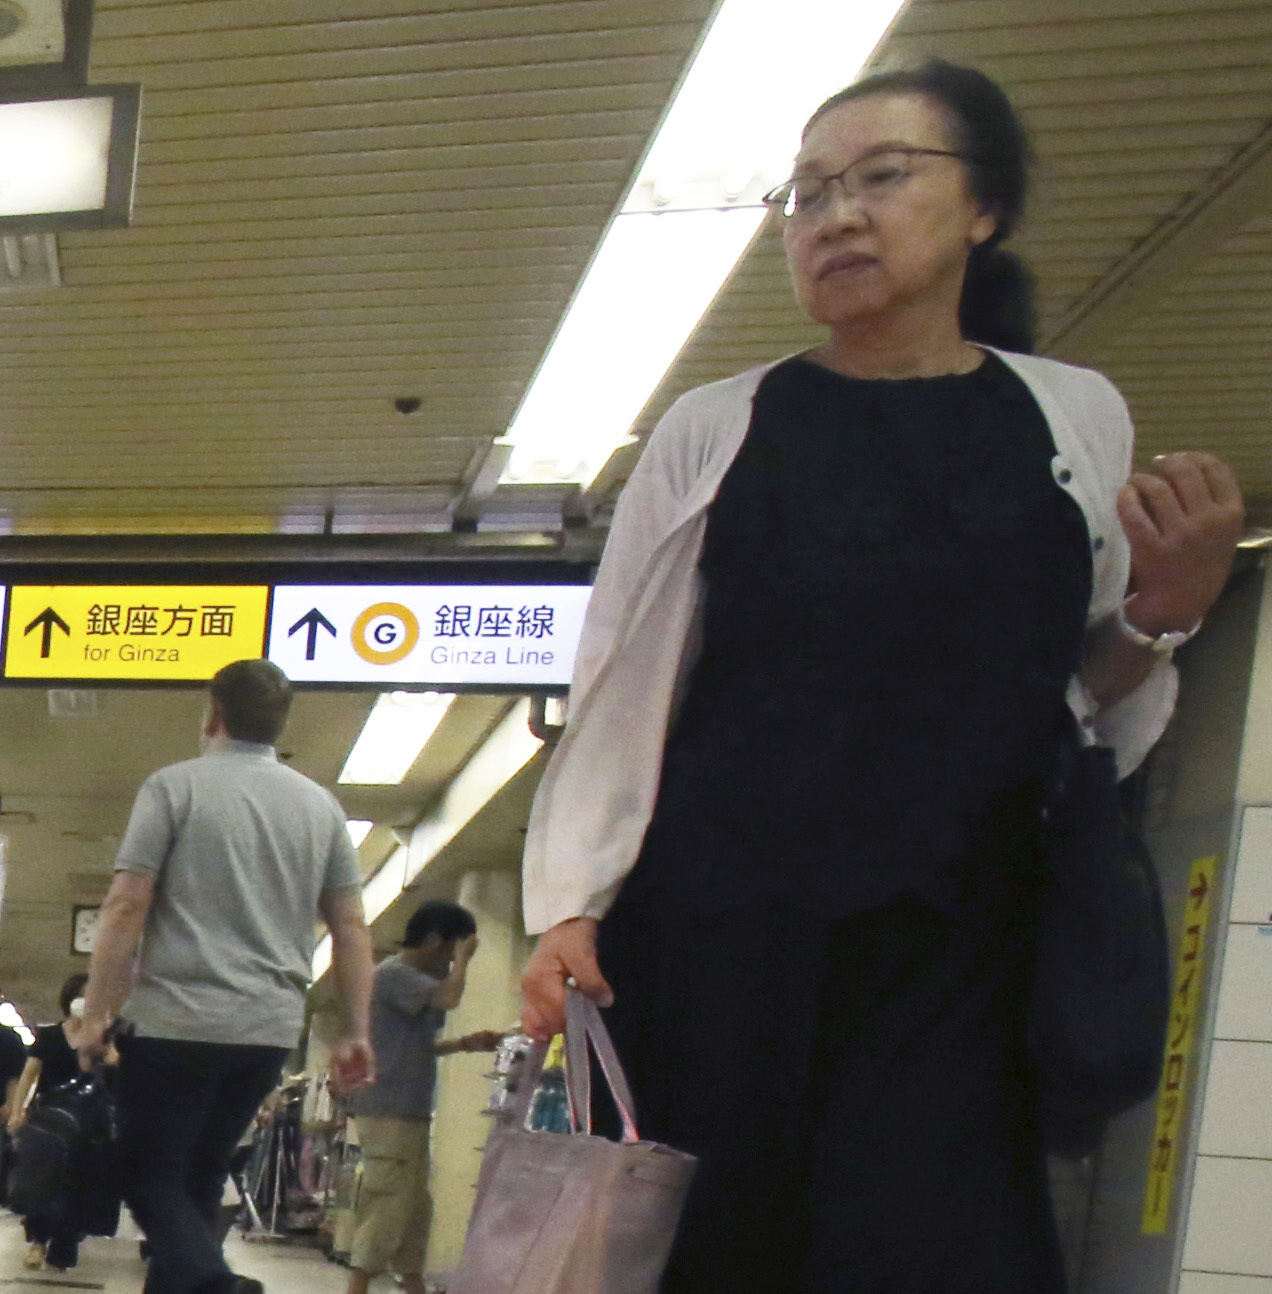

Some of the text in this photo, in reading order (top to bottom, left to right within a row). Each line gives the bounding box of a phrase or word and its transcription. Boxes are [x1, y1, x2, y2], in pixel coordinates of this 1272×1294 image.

[86, 603, 237, 638] 銀座方面
[373, 622, 397, 645] G
[433, 603, 555, 638] 銀座線
[82, 643, 181, 663] for Ginza
[430, 646, 555, 667] Ginza Line
[1149, 926, 1200, 1214] コインロッカー
